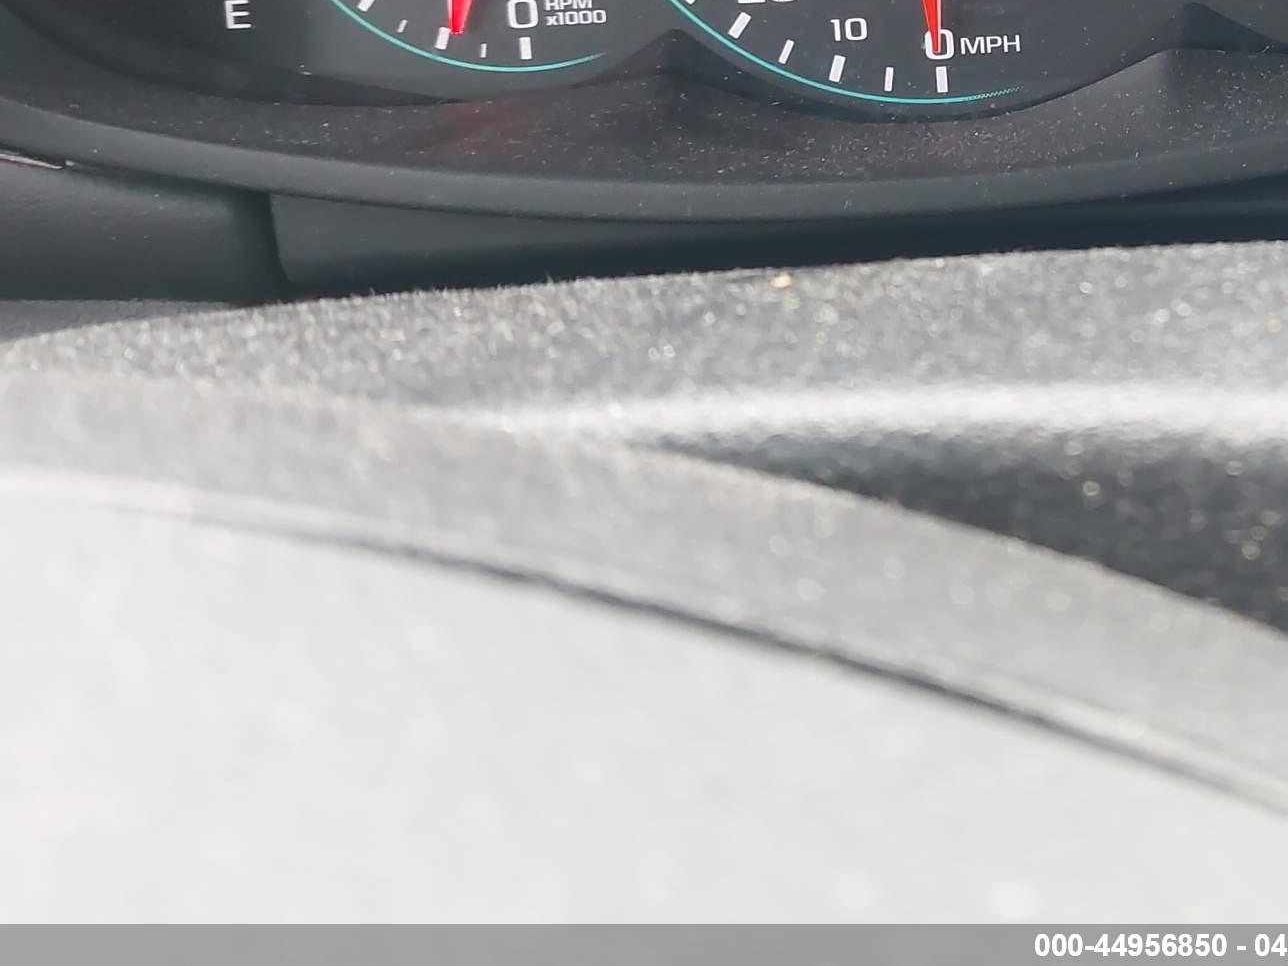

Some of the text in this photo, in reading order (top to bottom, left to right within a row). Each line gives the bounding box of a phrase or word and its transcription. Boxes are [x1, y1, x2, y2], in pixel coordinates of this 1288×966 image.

[224, 0, 252, 30] E
[546, 10, 607, 25] x1000
[831, 18, 867, 41] 10
[925, 30, 1021, 60] 0 MPH
